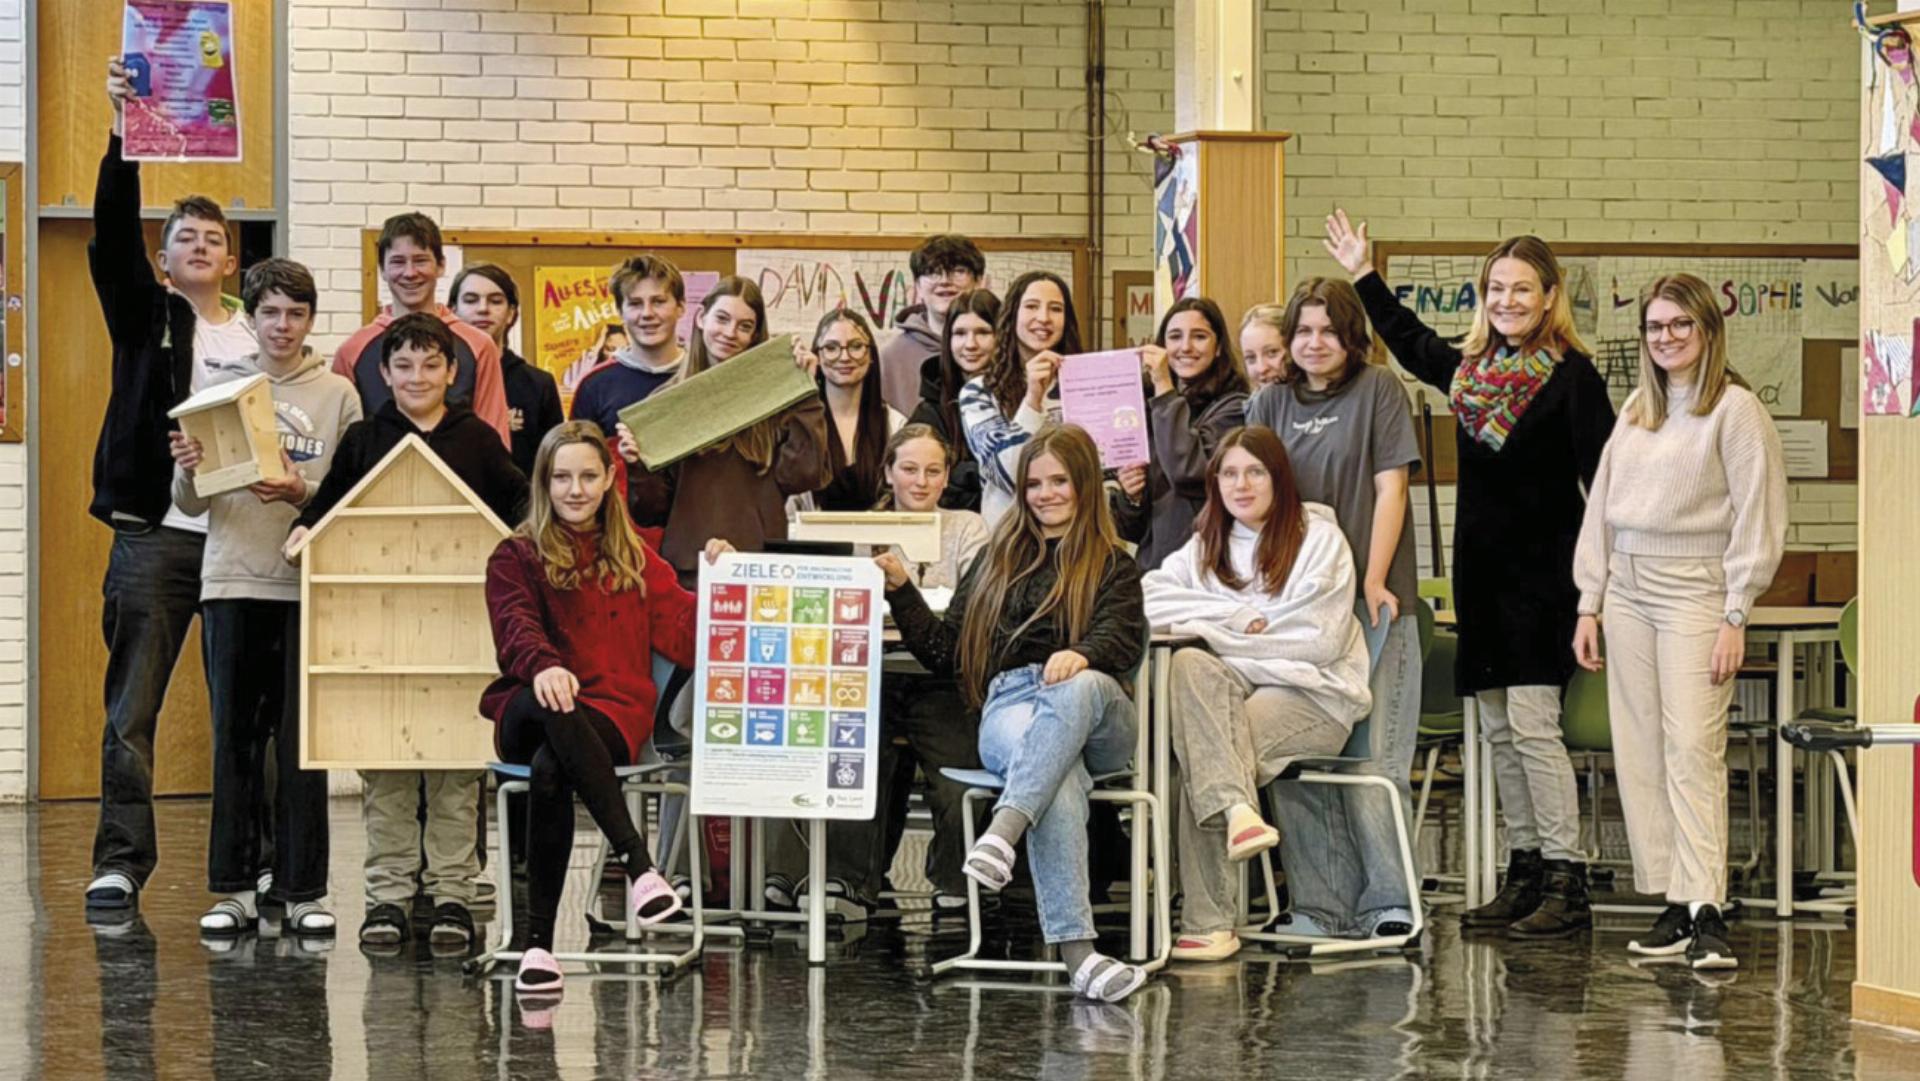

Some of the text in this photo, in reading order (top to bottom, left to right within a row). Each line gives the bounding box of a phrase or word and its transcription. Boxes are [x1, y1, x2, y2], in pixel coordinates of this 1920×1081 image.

[759, 262, 847, 312] DAVID
[1395, 282, 1476, 313] FINJA
[1721, 280, 1802, 316] SOPHIE
[732, 563, 780, 579] ZIELE
